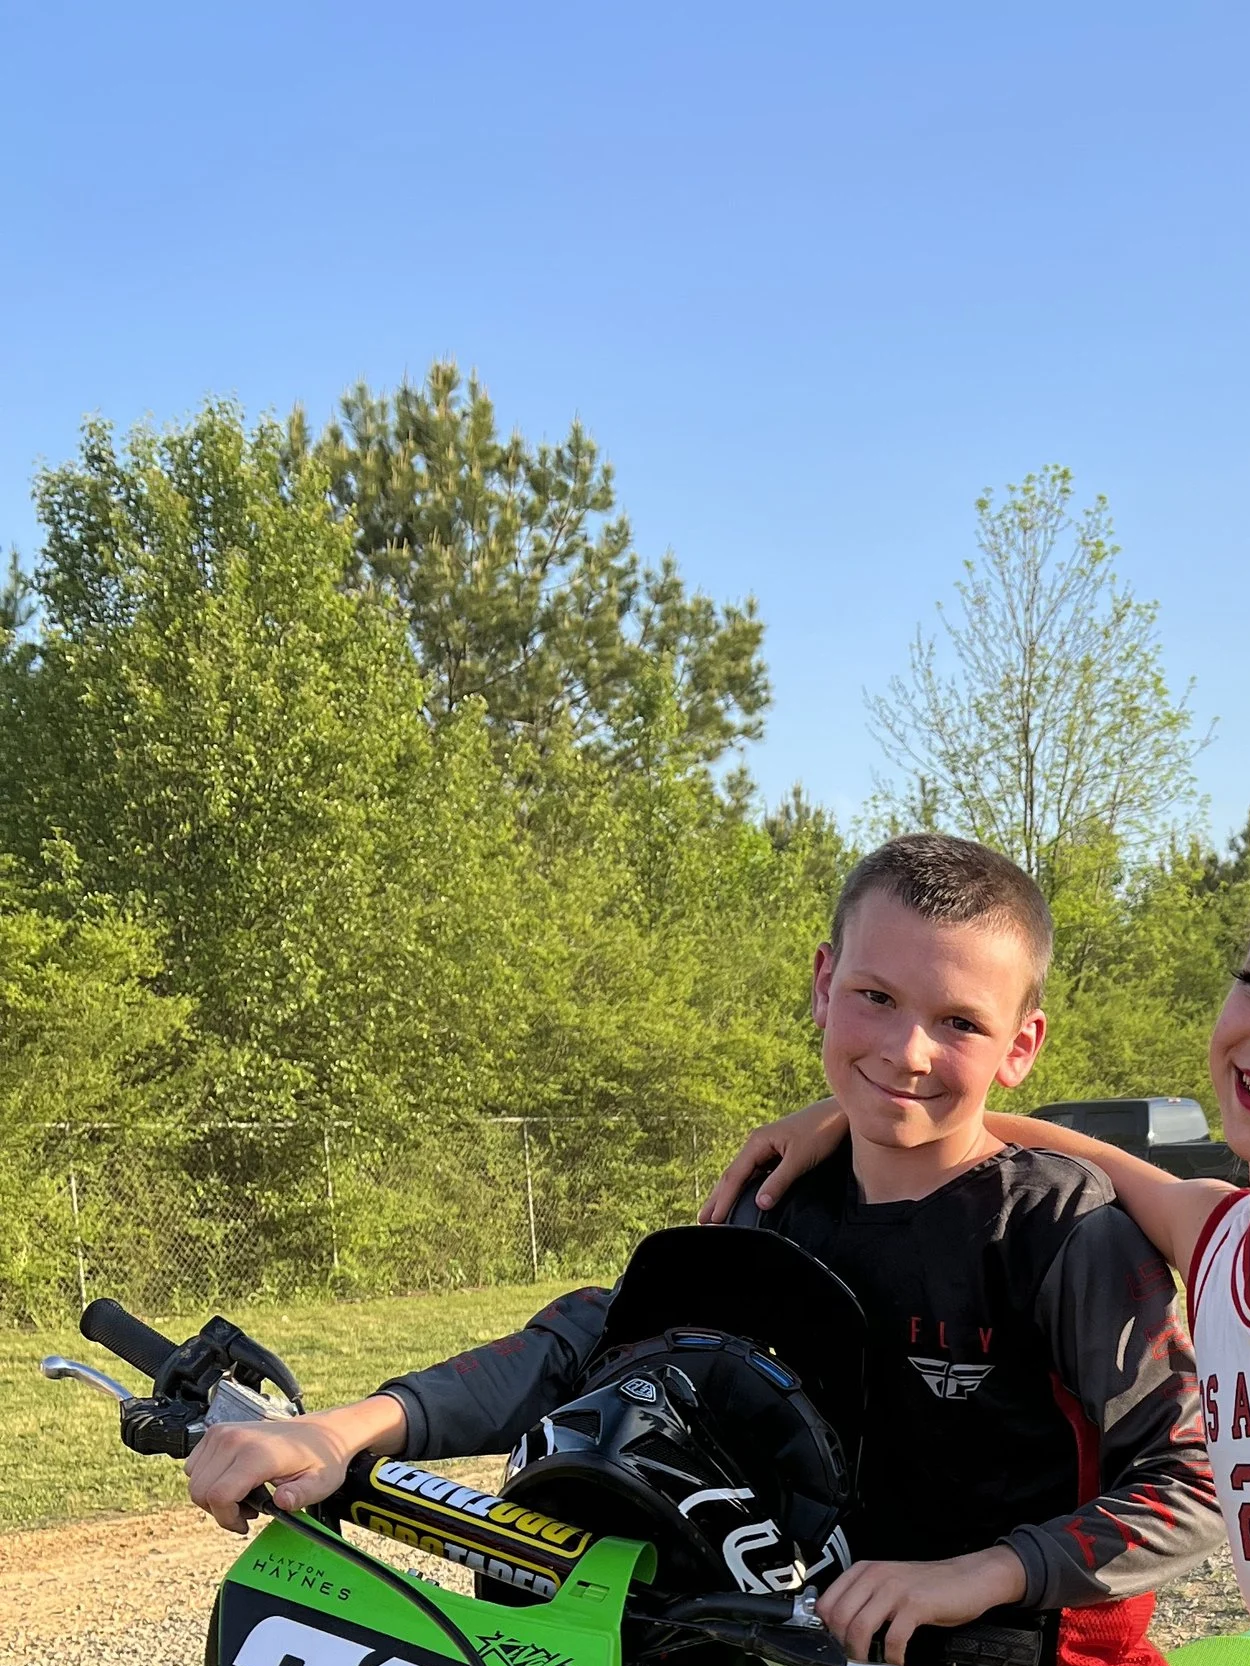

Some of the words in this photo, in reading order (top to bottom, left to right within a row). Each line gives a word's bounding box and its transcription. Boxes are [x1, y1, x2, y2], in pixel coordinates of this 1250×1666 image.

[910, 1316, 993, 1353] FLY
[252, 1558, 352, 1601] HAYNES
[268, 1553, 325, 1577] LAYTON
